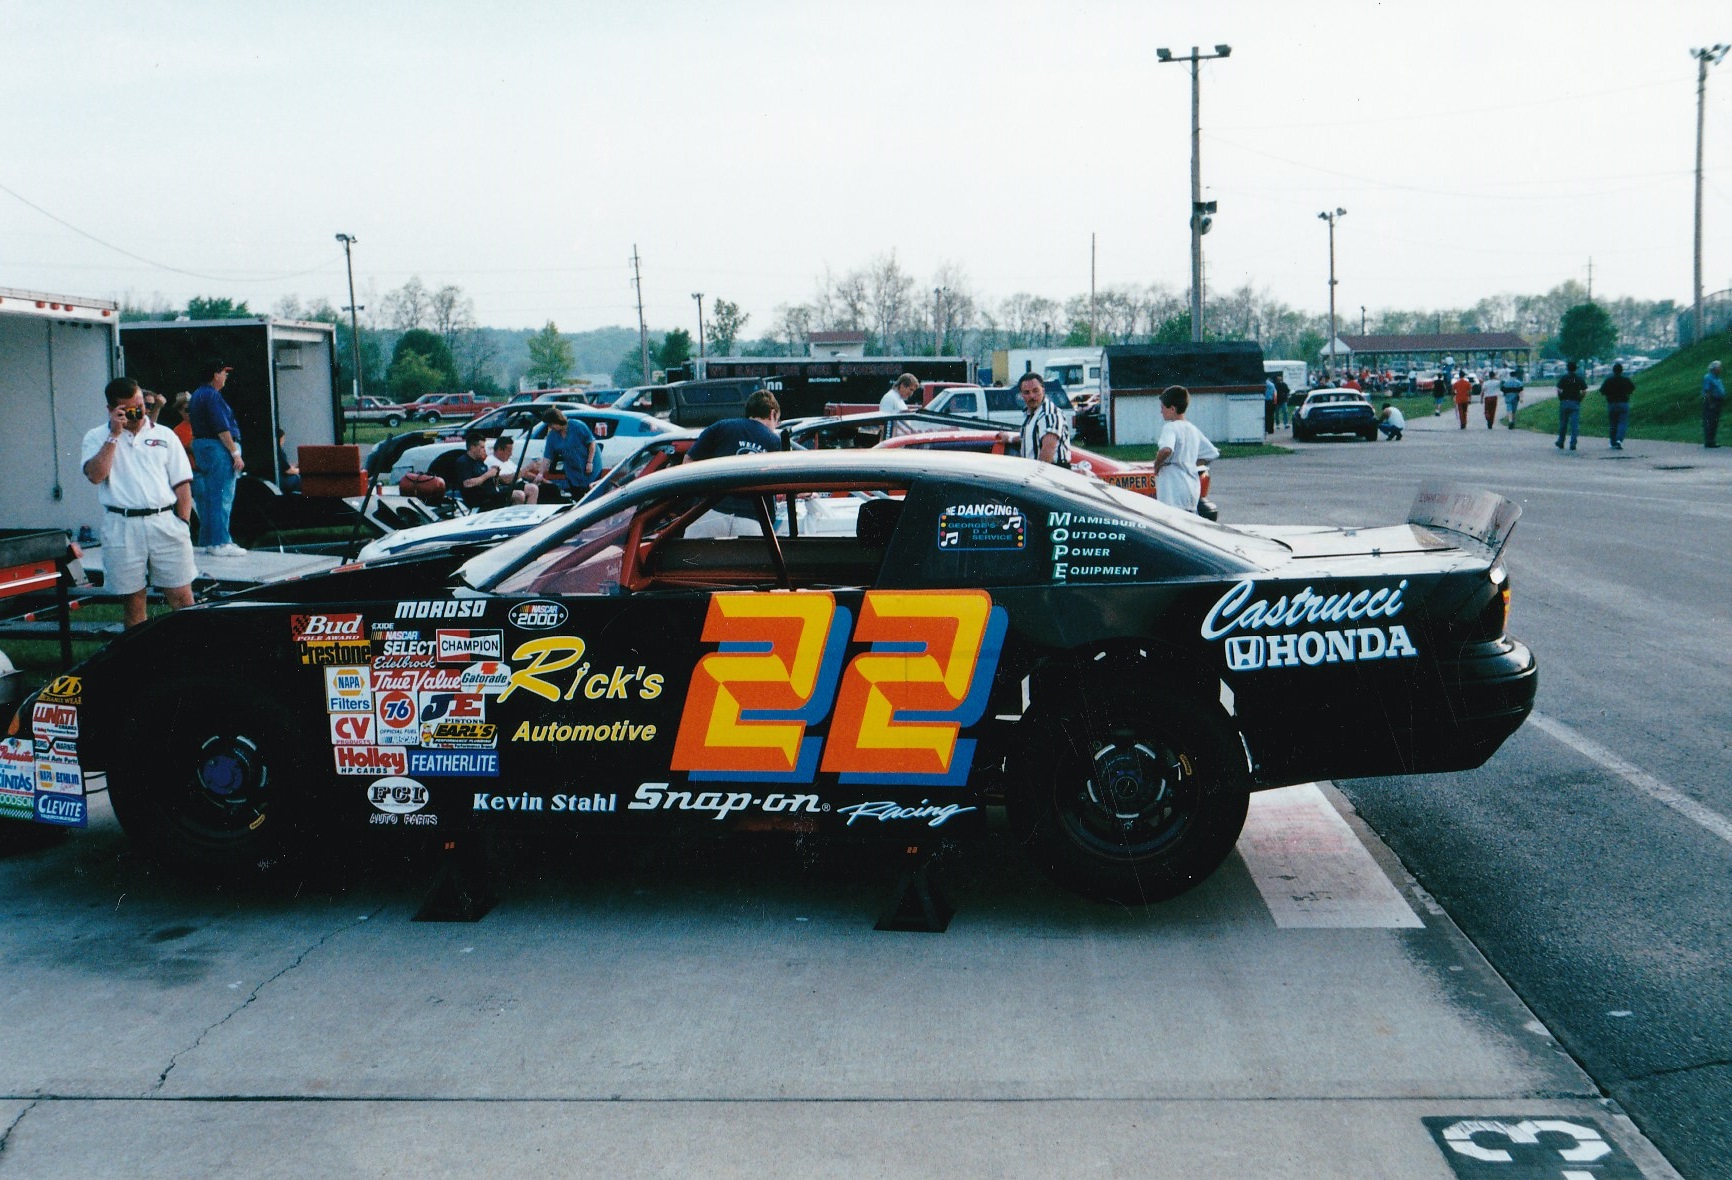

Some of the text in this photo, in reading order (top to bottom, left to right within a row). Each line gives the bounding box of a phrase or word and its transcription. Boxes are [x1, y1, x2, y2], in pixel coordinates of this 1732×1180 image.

[957, 504, 1013, 516] DANCING
[1050, 528, 1126, 543] OUTDOOR
[1051, 544, 1110, 560] POWER
[1052, 562, 1139, 579] EQUIPMENT
[395, 600, 487, 618] MOROSO
[532, 605, 558, 613] NASCAR
[1201, 579, 1409, 640] Castrucci
[303, 614, 364, 635] Bud
[371, 622, 395, 630] EXIDE
[517, 612, 558, 626] 2000
[386, 631, 419, 640] NASCAR
[300, 640, 371, 665] Prestone
[383, 640, 437, 656] SELECT
[441, 640, 499, 652] CHAMPION
[1266, 624, 1419, 668] HONDA
[373, 655, 437, 670] Edelbrock
[496, 635, 664, 704] Rick's
[338, 676, 360, 689] NAPA
[461, 672, 508, 684] Gatorade
[670, 589, 1008, 786] 22
[330, 698, 370, 710] Filters
[385, 699, 411, 720] 76
[421, 693, 484, 722] JE
[335, 717, 370, 740] CV
[436, 725, 493, 737] EARL'S
[512, 720, 657, 742] Automotive
[337, 747, 406, 775] Holley
[411, 754, 497, 772] FEATHERLITE
[371, 786, 427, 804] FCI
[472, 791, 618, 812] Kevin Stahl
[38, 794, 83, 817] CLEVITE
[836, 798, 978, 828] Racing
[369, 812, 438, 825] AUTO PARTS
